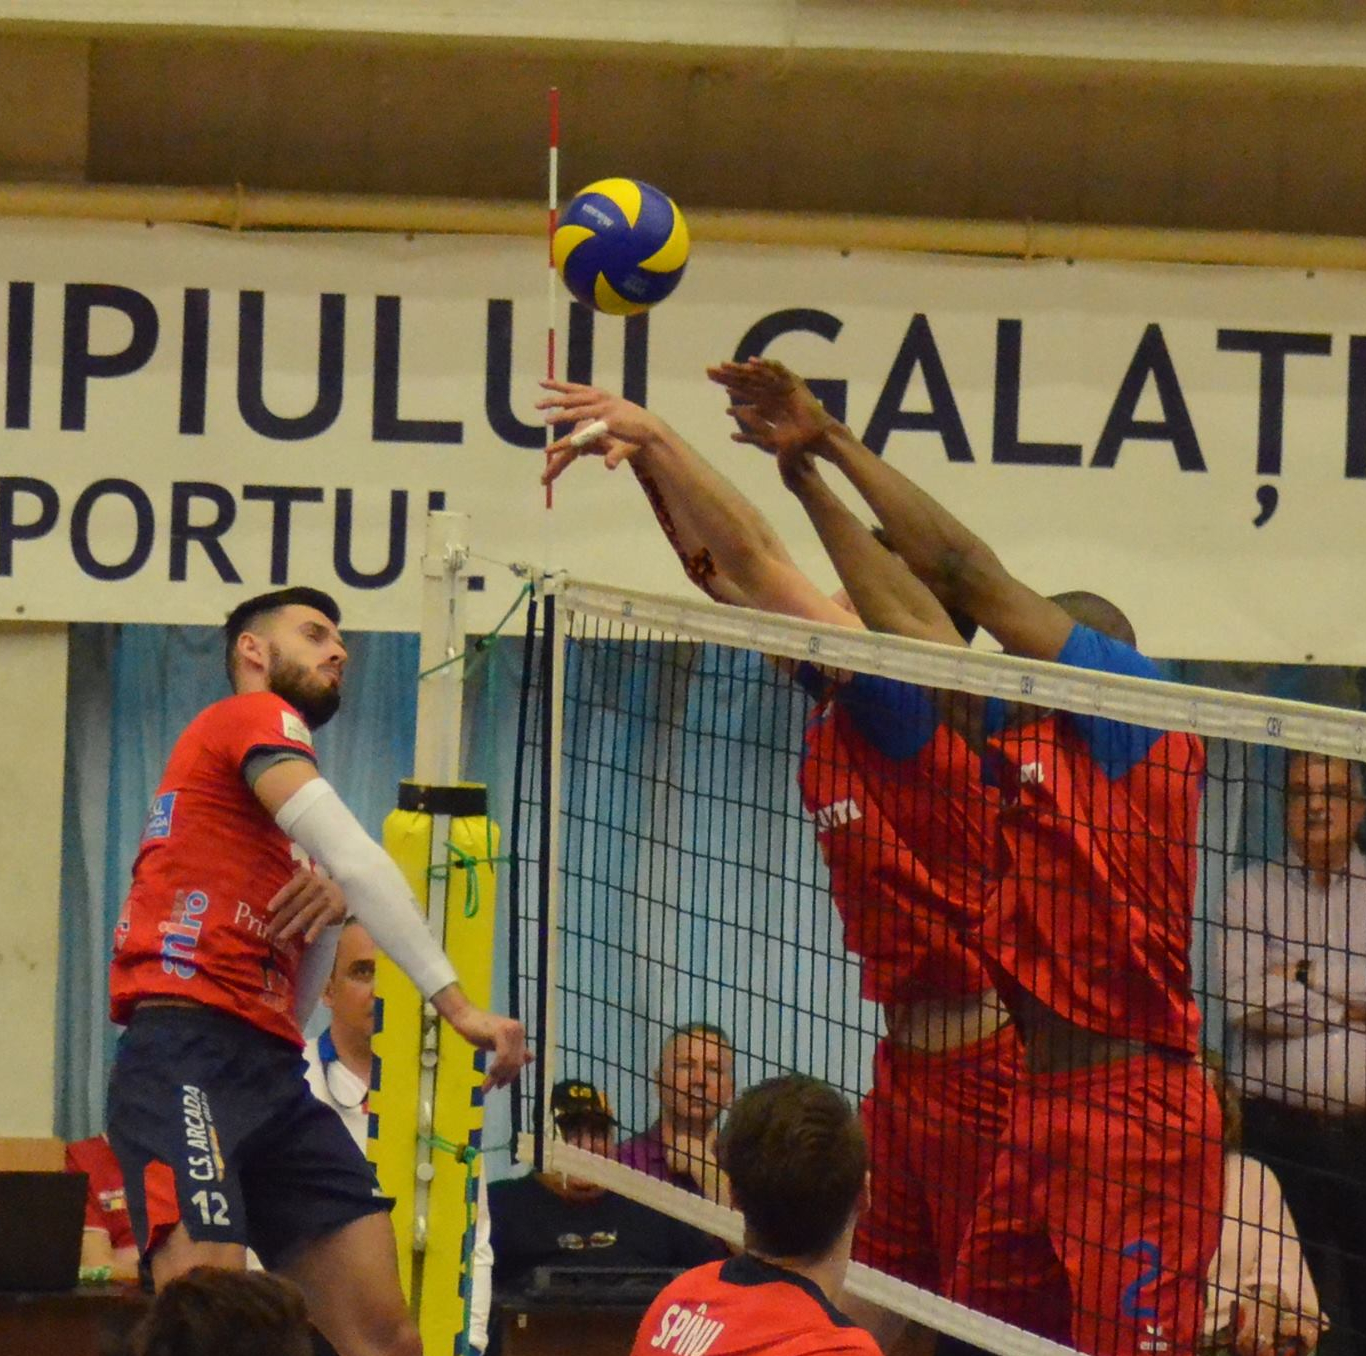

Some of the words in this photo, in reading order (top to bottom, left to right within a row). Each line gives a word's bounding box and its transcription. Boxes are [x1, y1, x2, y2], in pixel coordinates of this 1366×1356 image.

[182, 1084, 211, 1152] ARCADA
[191, 1189, 231, 1226] 12
[1121, 1240, 1161, 1318] 2
